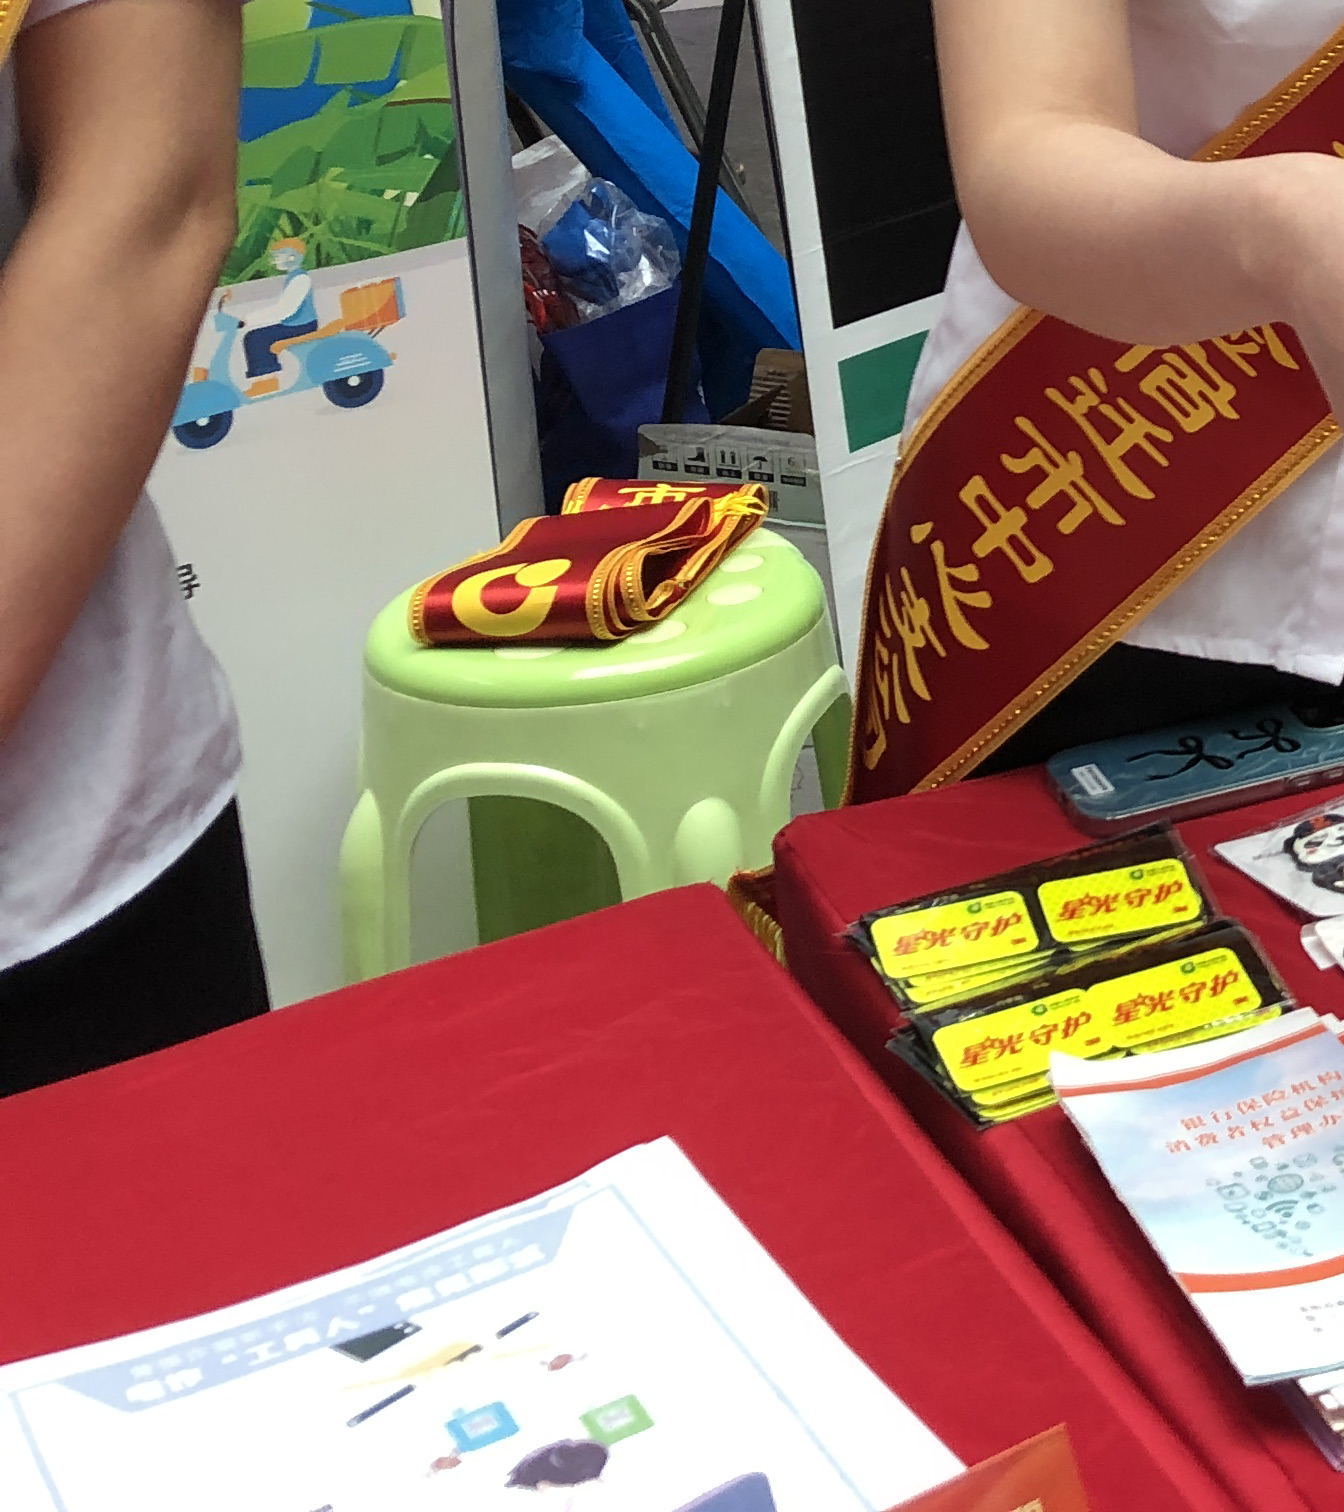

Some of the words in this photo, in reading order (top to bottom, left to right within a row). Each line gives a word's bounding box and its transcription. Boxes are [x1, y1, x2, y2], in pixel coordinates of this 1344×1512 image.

[1059, 879, 1184, 922] 星光守护
[892, 911, 1023, 956] 星光守护
[1113, 969, 1241, 1027] 星光守护
[960, 1011, 1093, 1069] 星光守护
[1180, 1070, 1343, 1131] 银行保险机构
